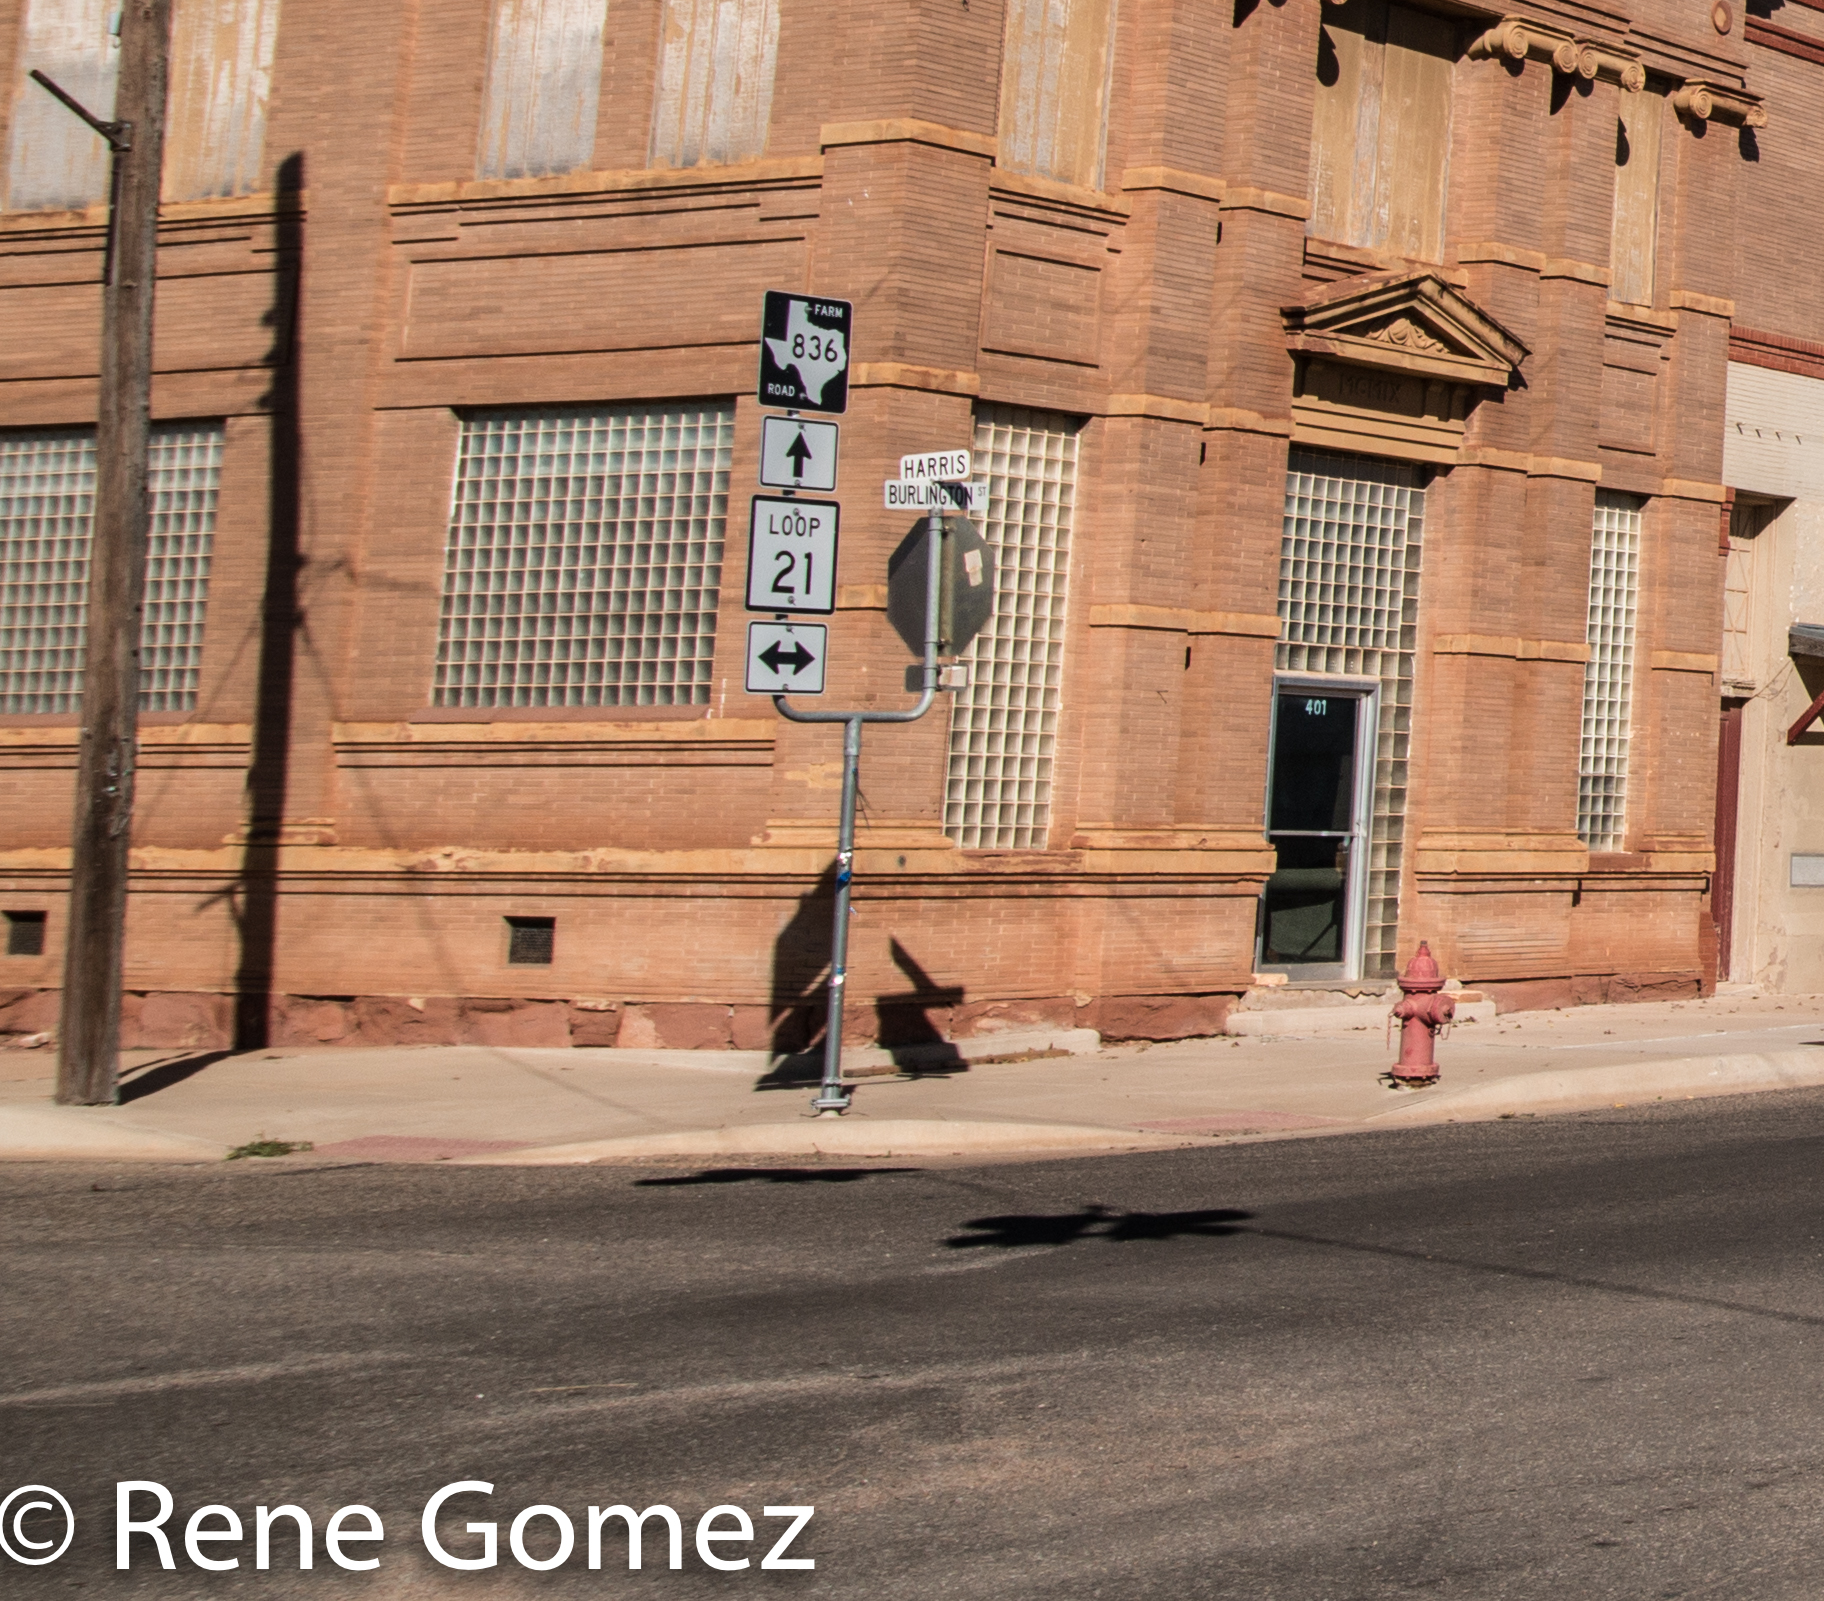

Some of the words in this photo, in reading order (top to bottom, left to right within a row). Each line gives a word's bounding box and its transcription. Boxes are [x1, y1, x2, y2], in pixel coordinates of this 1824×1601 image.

[814, 303, 844, 319] FARM
[791, 333, 839, 363] 836
[767, 382, 796, 398] ROAD
[904, 454, 967, 480] HARRIS
[888, 484, 974, 506] BURLINGTON
[977, 485, 987, 497] ST
[769, 514, 821, 538] LOOP
[771, 550, 814, 596] 21
[1305, 699, 1328, 716] 401
